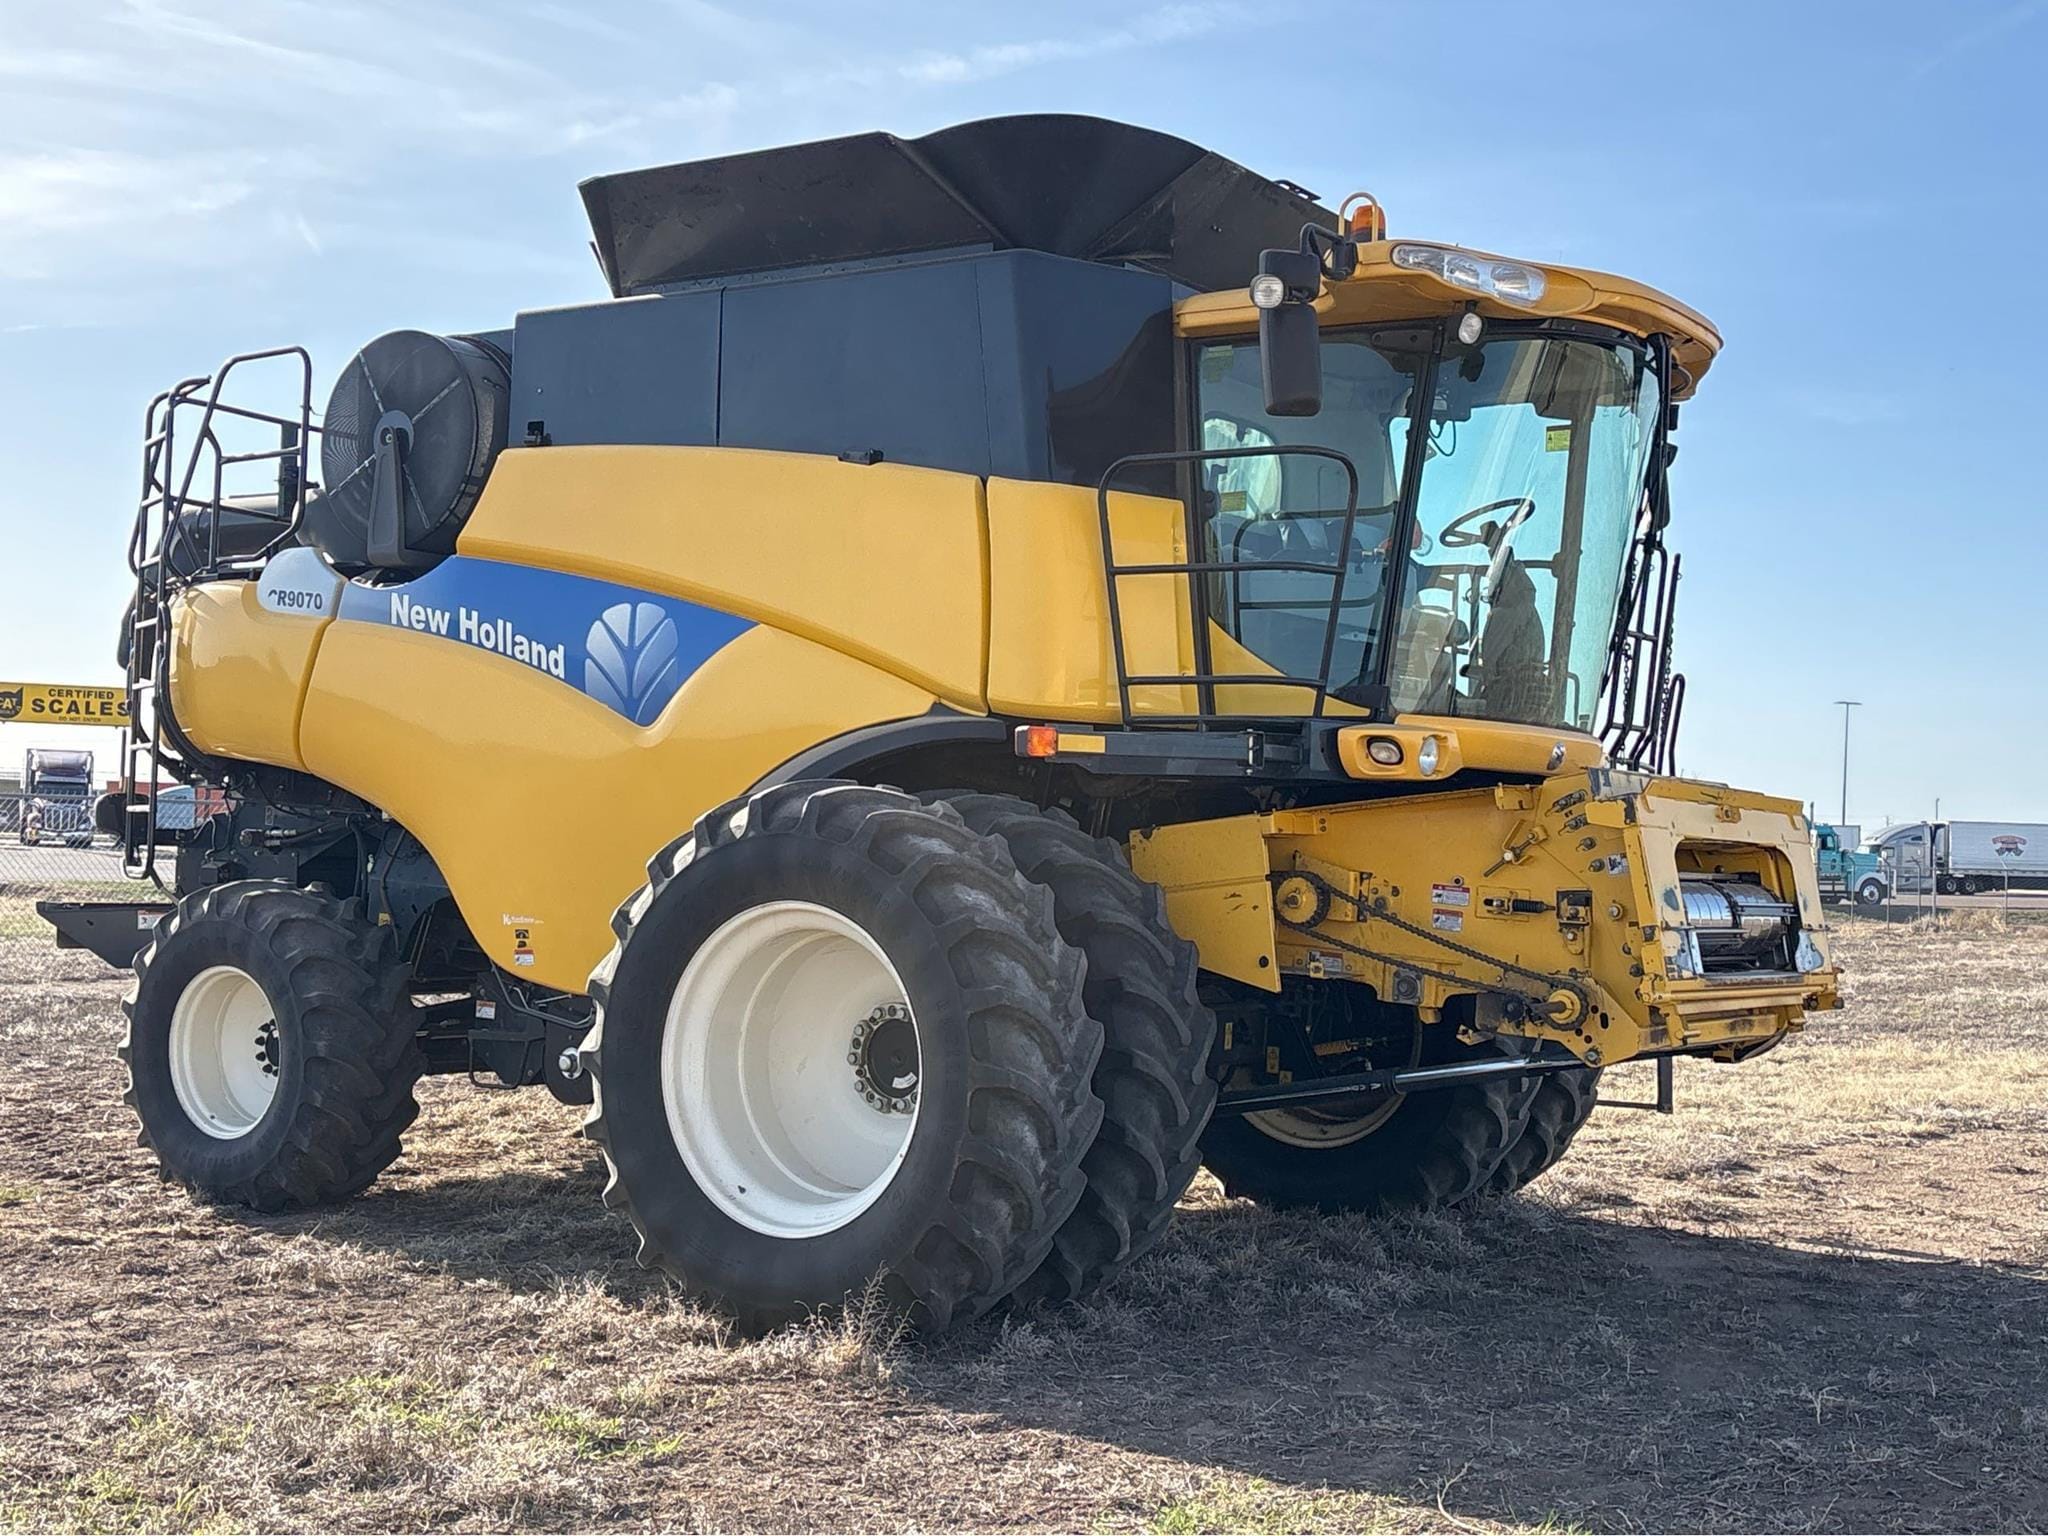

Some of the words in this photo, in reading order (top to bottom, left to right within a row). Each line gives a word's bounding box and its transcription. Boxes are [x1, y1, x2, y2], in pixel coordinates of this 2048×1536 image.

[390, 592, 450, 635] New
[458, 606, 565, 679] Holland
[48, 688, 115, 700] CERTIFIED
[31, 698, 130, 716] SCALES
